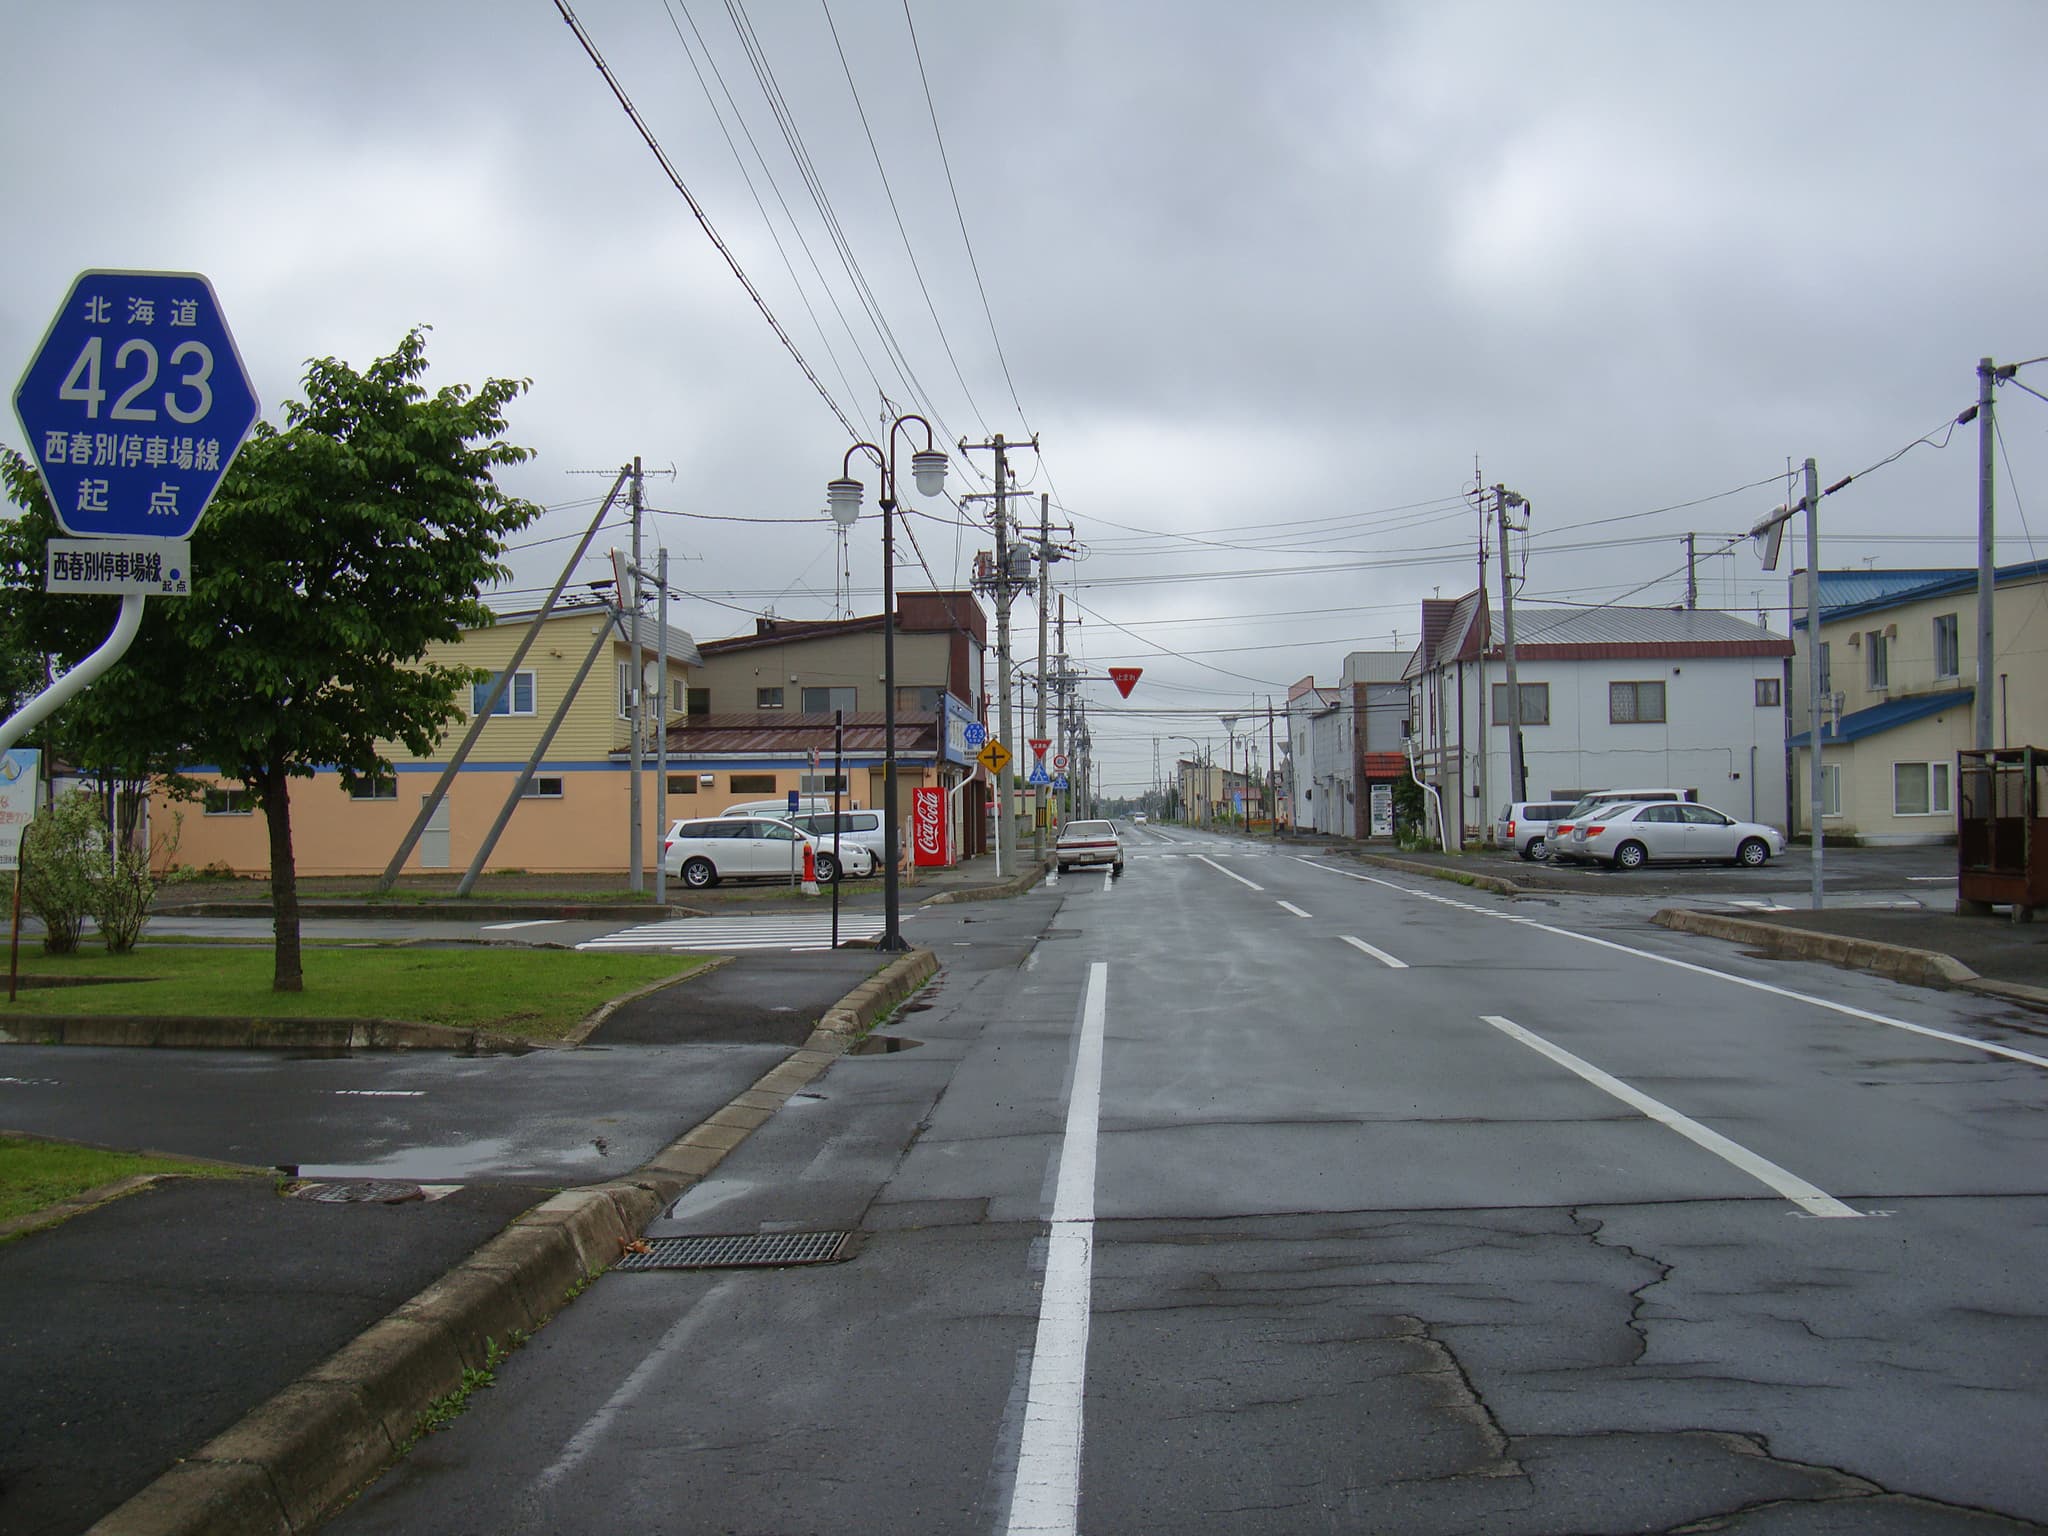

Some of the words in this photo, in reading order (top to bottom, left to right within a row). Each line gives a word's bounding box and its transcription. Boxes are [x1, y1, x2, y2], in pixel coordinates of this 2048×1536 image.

[83, 296, 199, 327] 北海道
[58, 336, 214, 425] 423
[45, 430, 220, 472] 西春別停車場線
[76, 478, 181, 517] 起点
[53, 550, 163, 583] 西春別停車場線
[161, 579, 188, 594] 起点
[1115, 672, 1136, 681] 止まれ
[966, 729, 985, 739] 423
[917, 788, 939, 855] Coca-Cola
